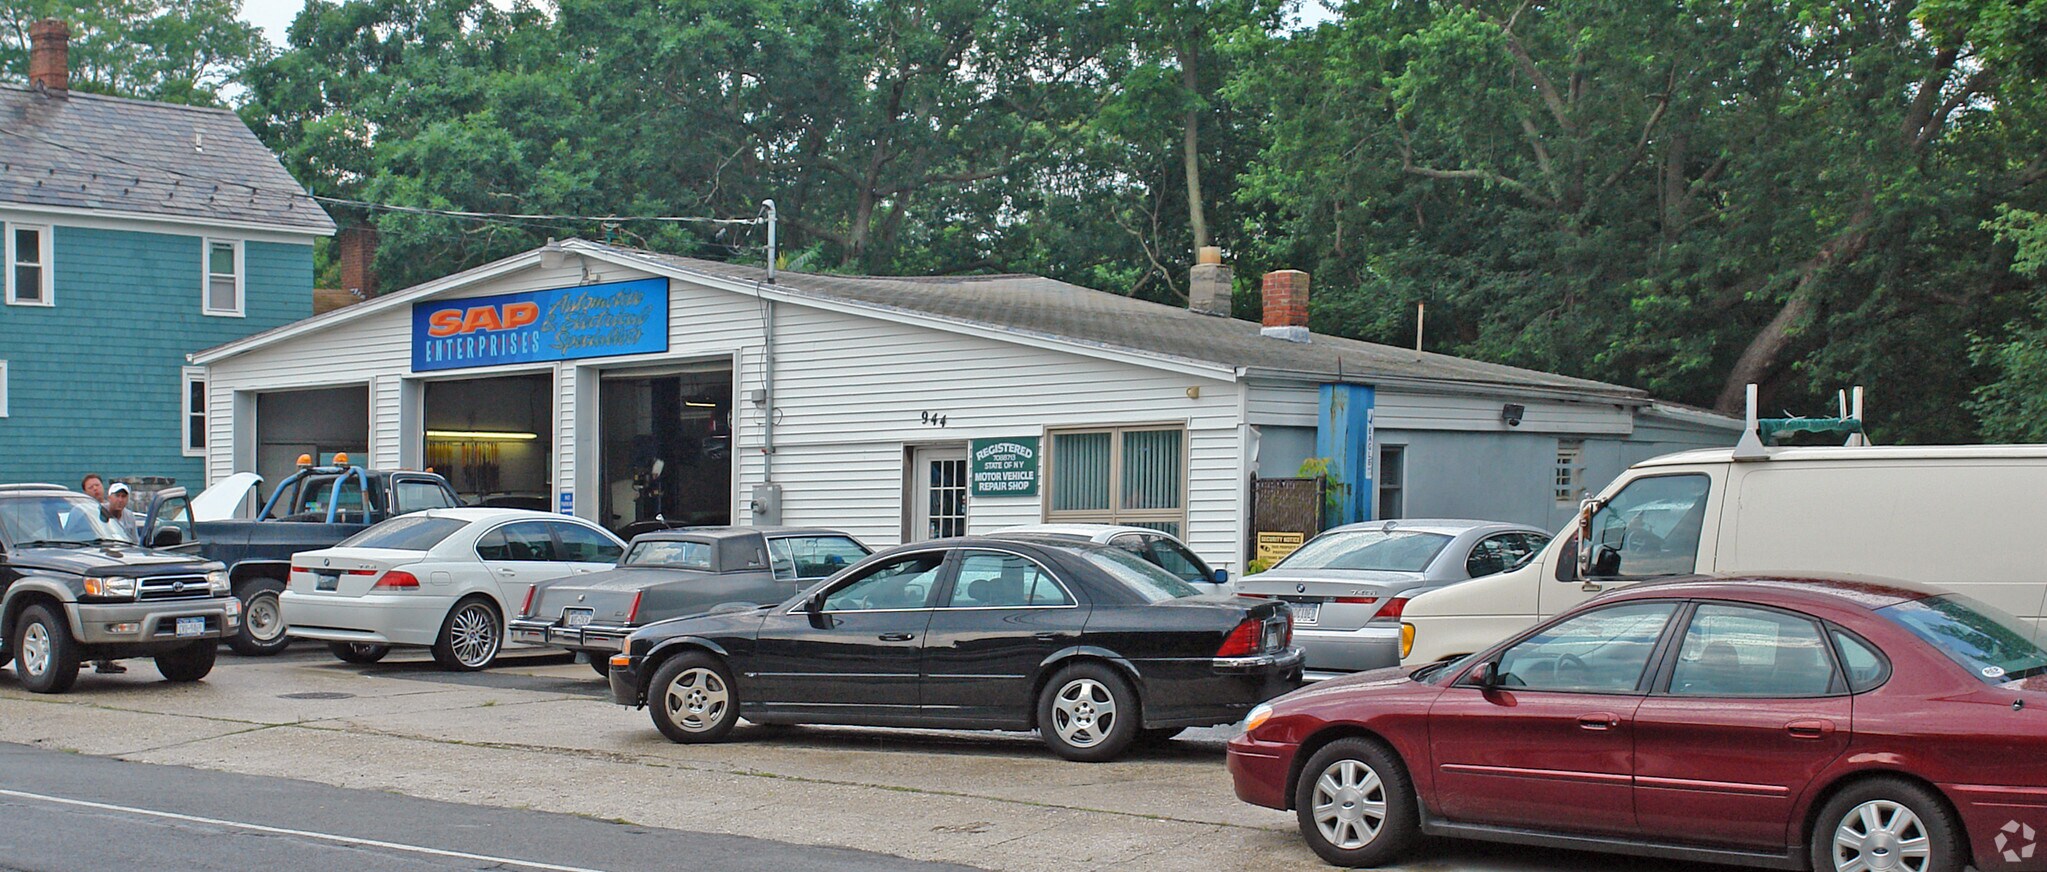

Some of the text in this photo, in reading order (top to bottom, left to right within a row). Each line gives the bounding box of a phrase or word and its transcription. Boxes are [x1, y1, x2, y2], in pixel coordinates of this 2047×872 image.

[549, 288, 644, 315] Automotive
[428, 301, 540, 338] SAP
[541, 305, 654, 332] & Electrical
[426, 330, 540, 362] ENTERPRISES
[921, 410, 947, 428] 944
[976, 442, 1034, 461] REGISTERED
[984, 461, 1003, 470] STATE
[1003, 461, 1013, 469] OF
[974, 470, 1034, 482] MOTOR VEHICLE
[979, 481, 1030, 491] REPAIR SHOP
